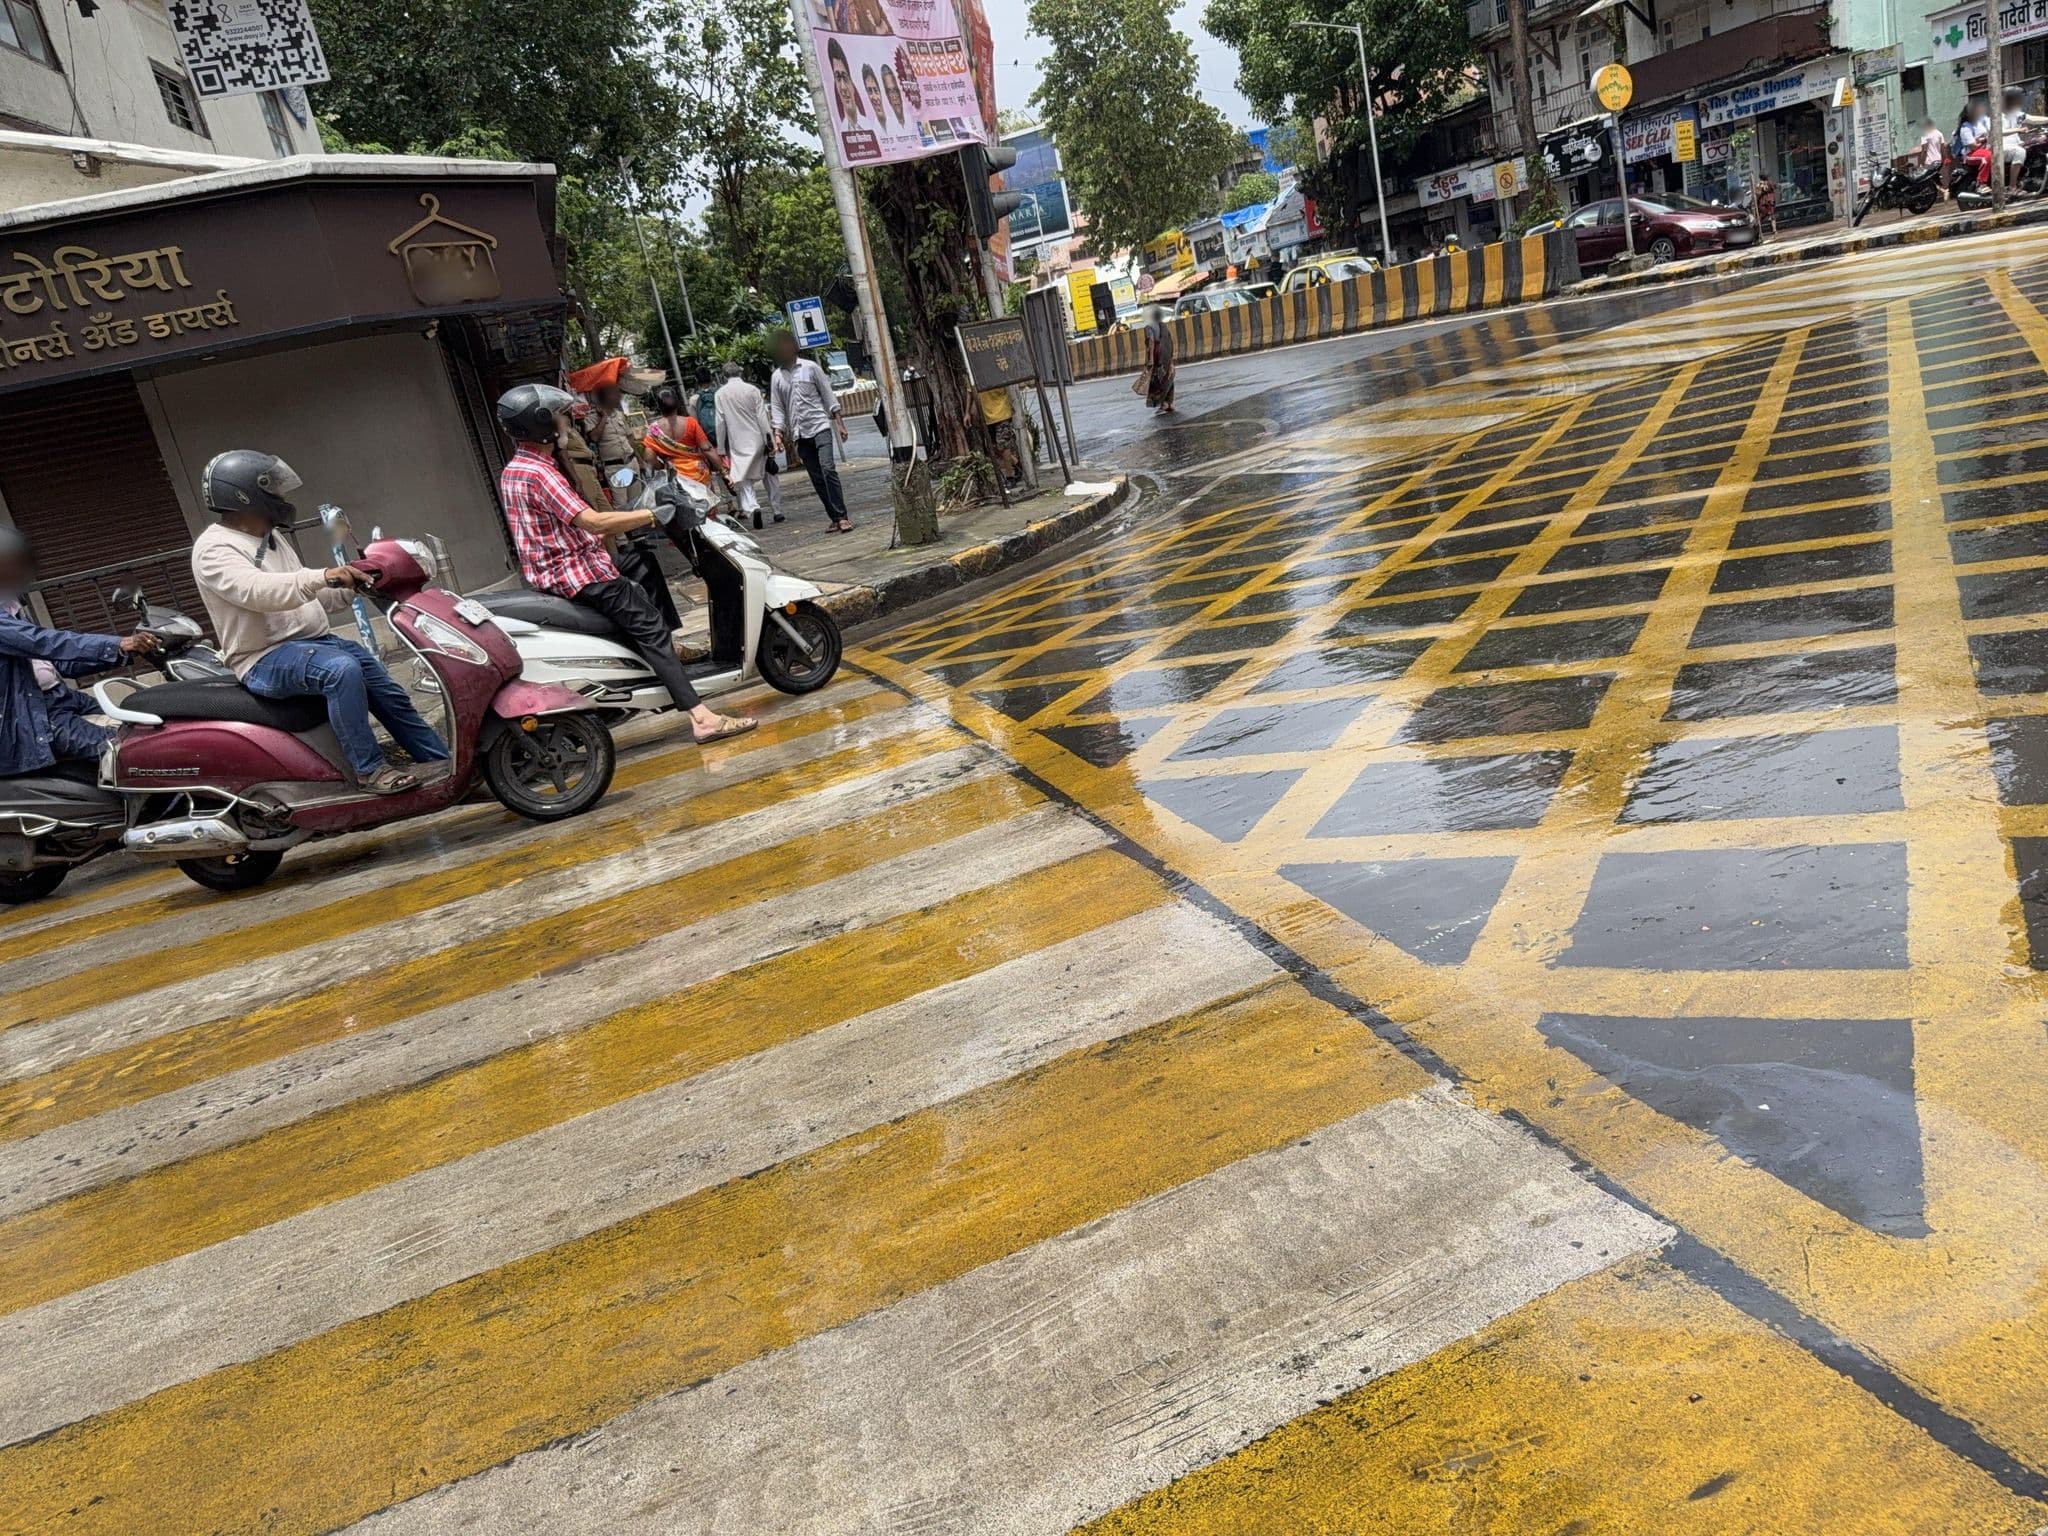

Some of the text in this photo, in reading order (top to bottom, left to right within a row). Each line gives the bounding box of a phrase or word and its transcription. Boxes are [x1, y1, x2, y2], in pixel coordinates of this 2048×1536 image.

[1709, 73, 1805, 110] The Cake House
[1625, 134, 1645, 151] SEE
[0, 246, 192, 314] टोरिया
[142, 289, 241, 338] डायर्स
